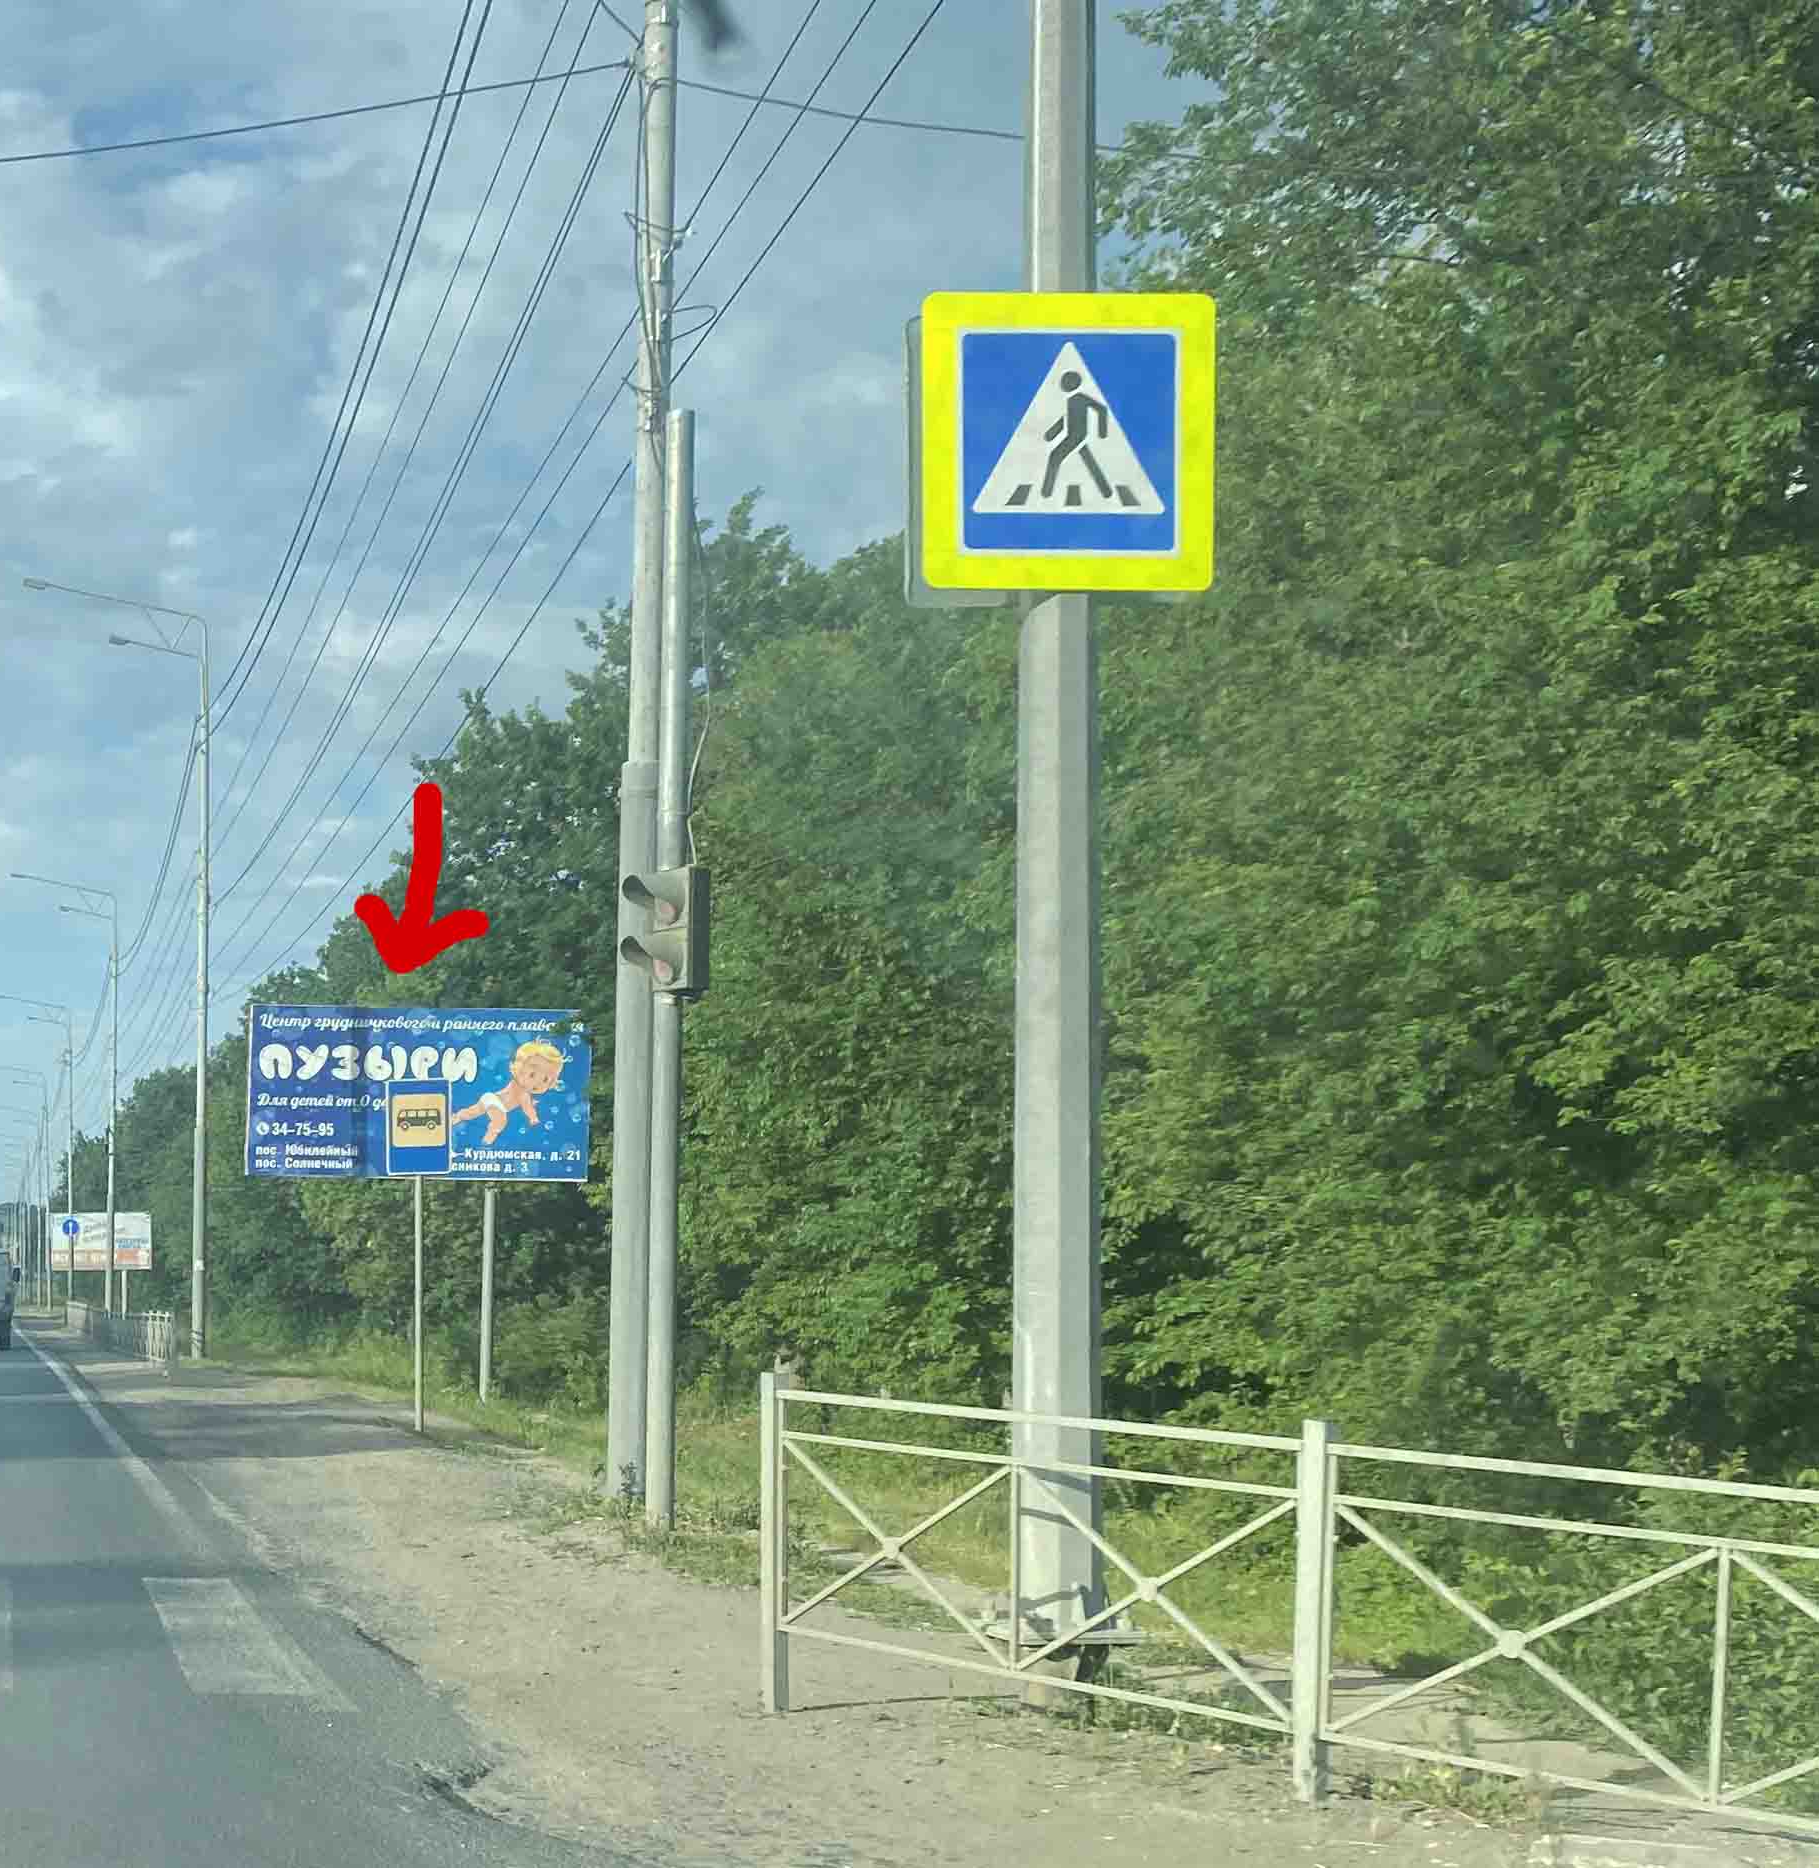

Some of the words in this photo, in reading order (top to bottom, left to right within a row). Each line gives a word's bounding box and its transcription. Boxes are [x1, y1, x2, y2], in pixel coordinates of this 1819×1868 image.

[259, 1013, 311, 1031] Центр
[313, 1015, 431, 1032] грудничкового
[442, 1018, 504, 1032] раннего
[259, 1043, 478, 1082] ПУЗЫРИ
[257, 1092, 288, 1107] Для
[290, 1094, 334, 1110] детей
[335, 1096, 356, 1107] от
[272, 1122, 335, 1137] 34-75-95
[566, 1149, 581, 1161] 21
